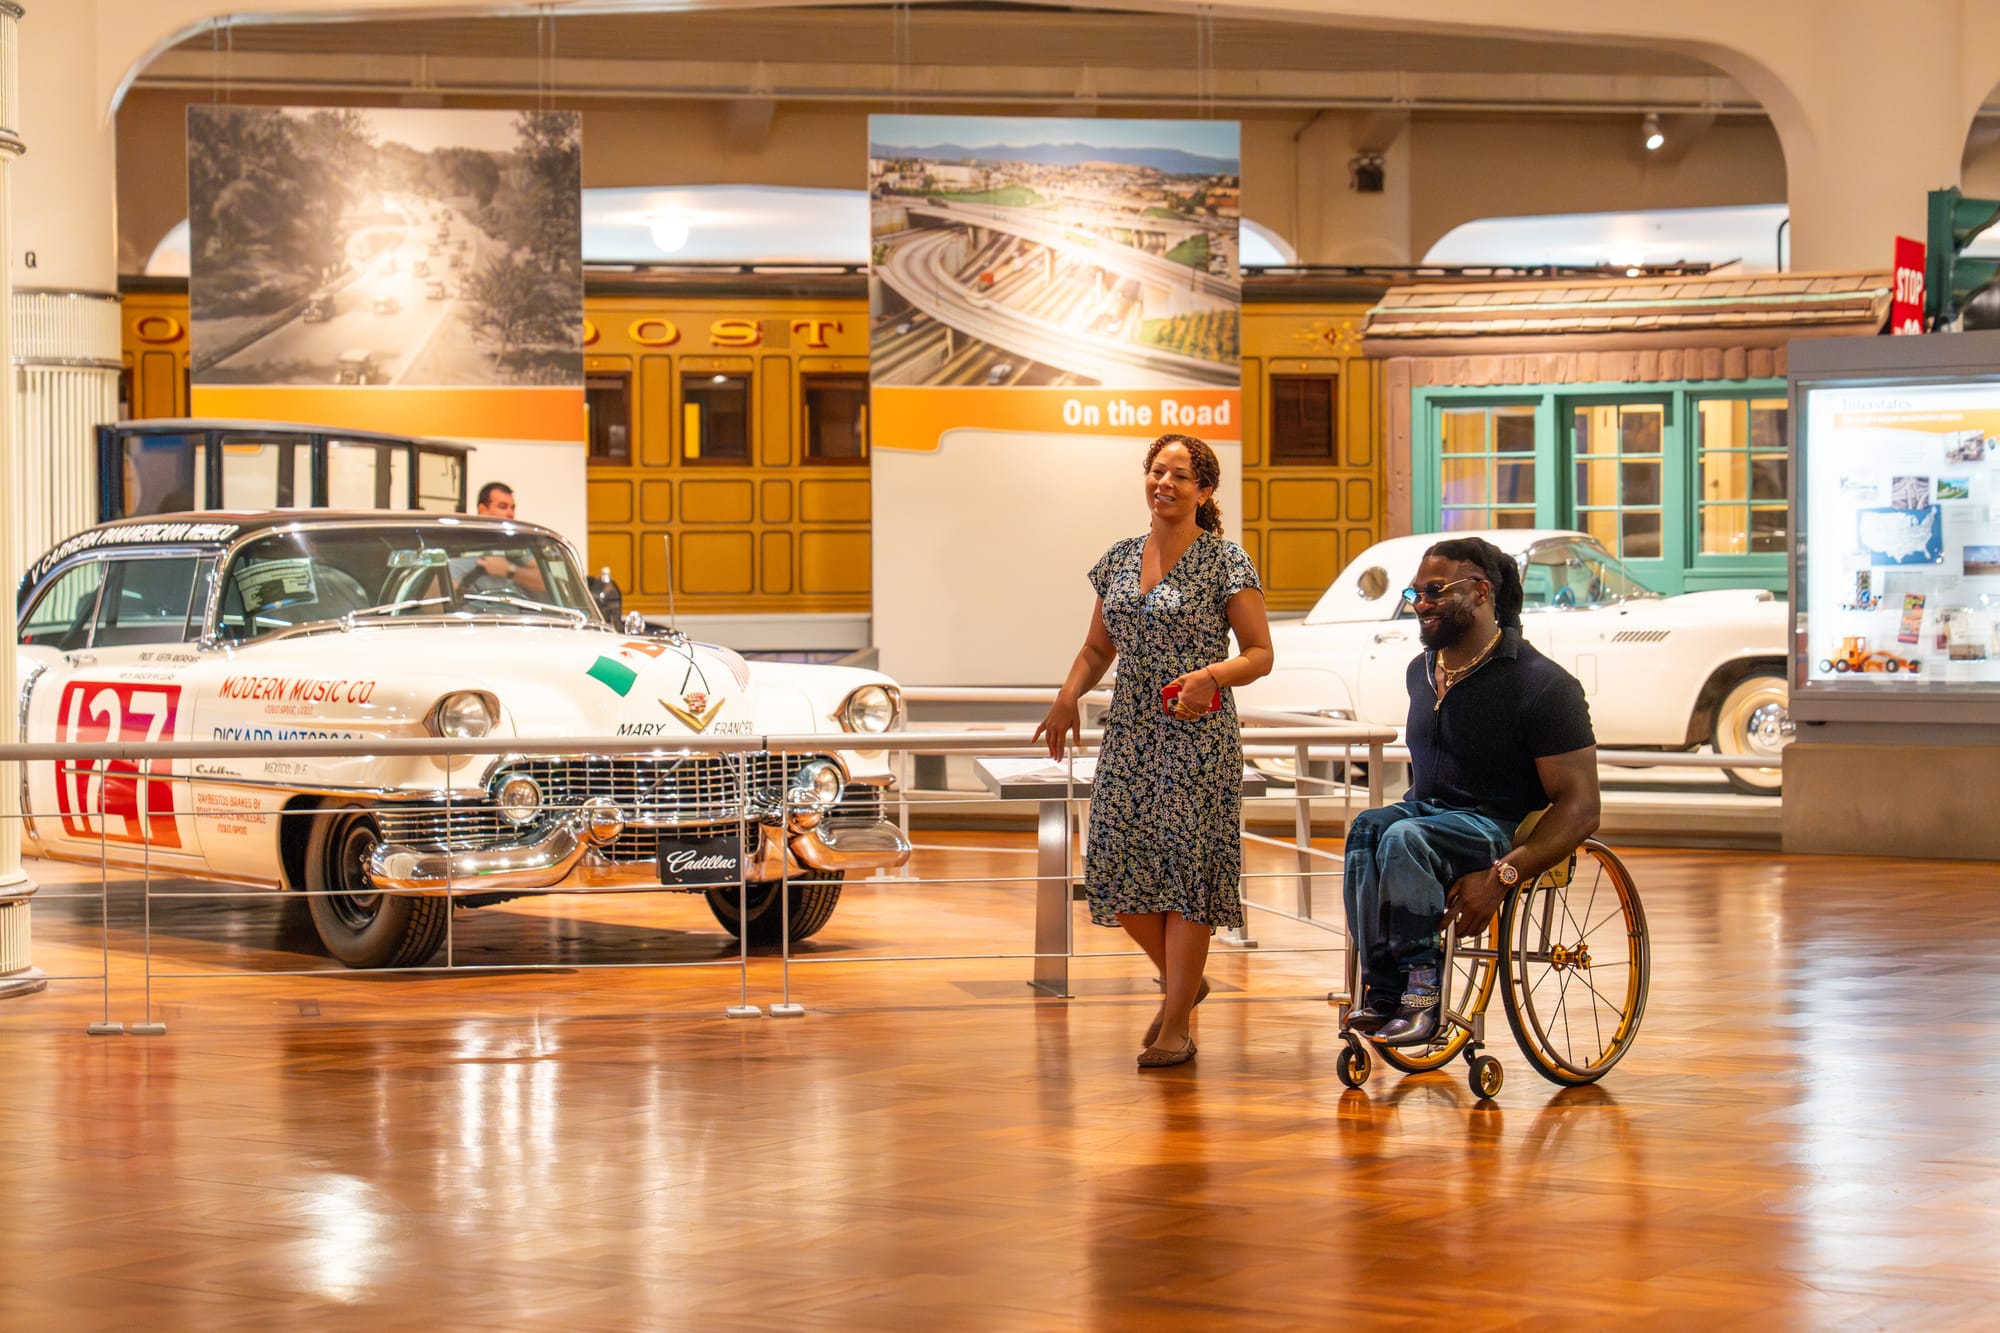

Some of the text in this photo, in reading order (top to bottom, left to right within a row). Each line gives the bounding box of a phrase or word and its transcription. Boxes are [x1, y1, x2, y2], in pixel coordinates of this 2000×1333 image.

[1896, 267, 1924, 305] STOP
[583, 317, 843, 348] OST
[1063, 399, 1231, 426] On the Road
[1842, 398, 1912, 410] Interstates
[218, 676, 376, 705] MODERN MUSIC CO.
[616, 723, 666, 735] MARY
[713, 721, 753, 735] FRANCES
[66, 686, 168, 838] 127
[253, 798, 261, 809] BY
[667, 849, 737, 873] Cadillac
